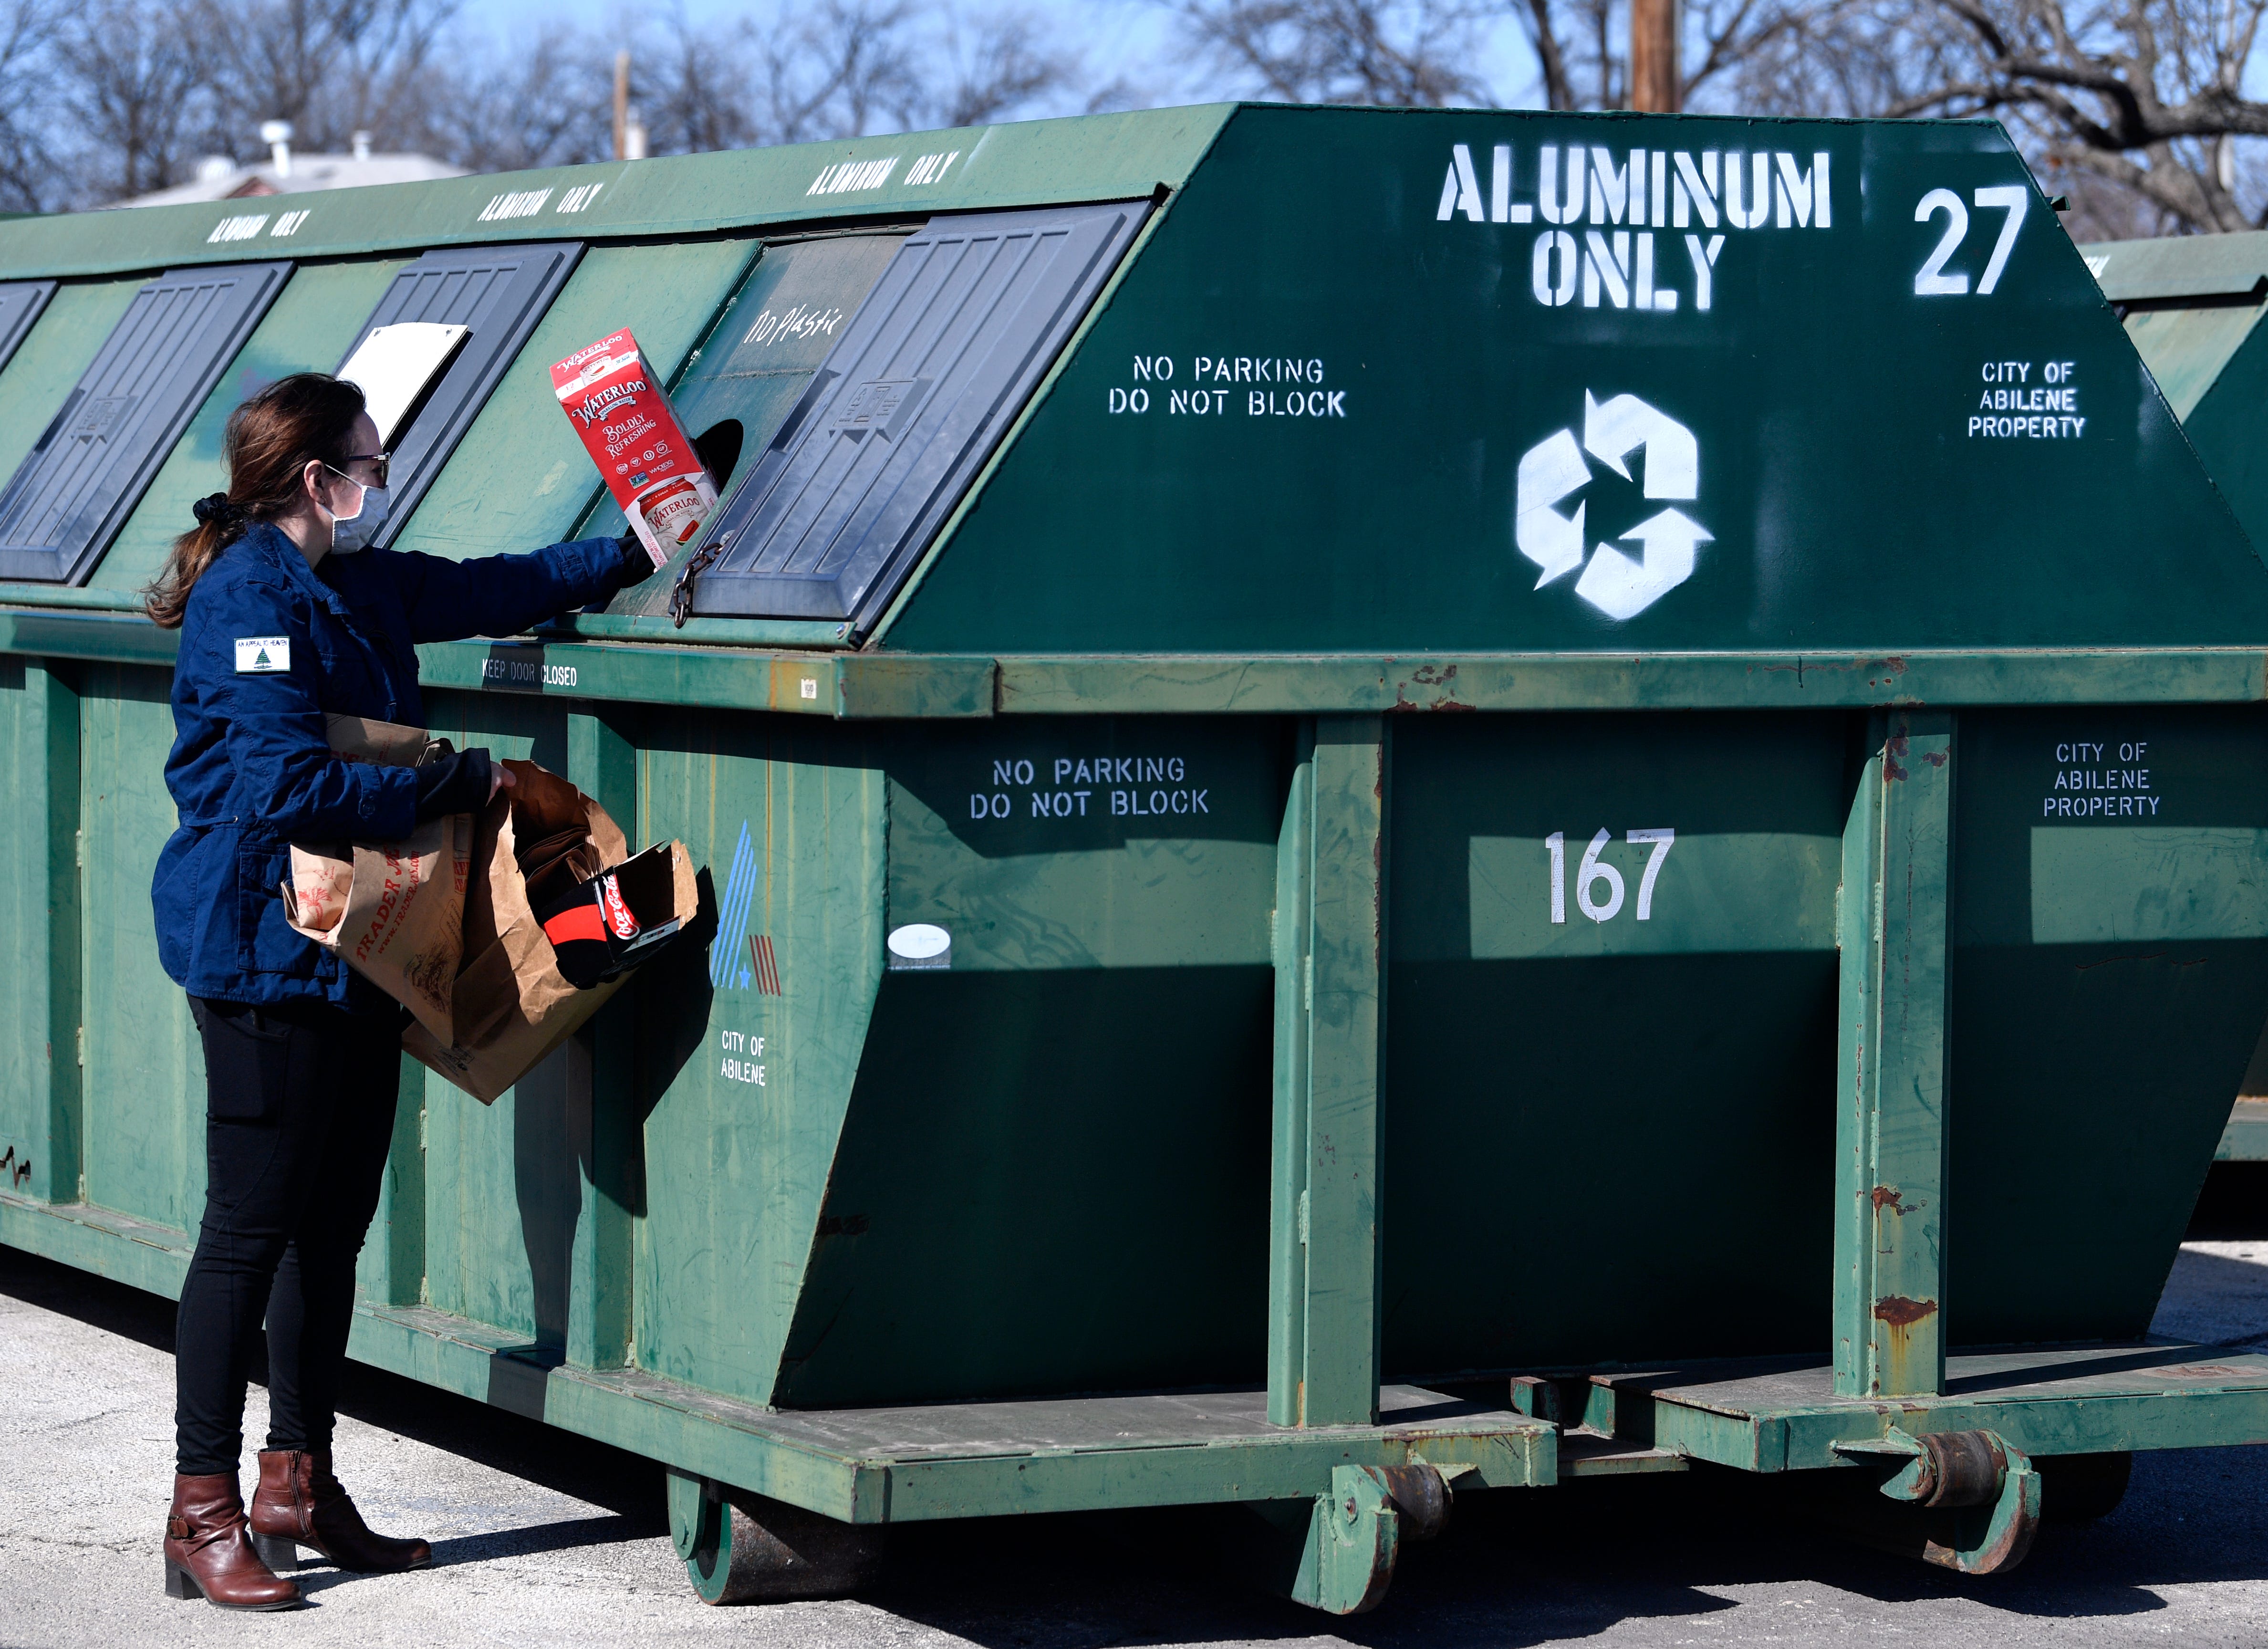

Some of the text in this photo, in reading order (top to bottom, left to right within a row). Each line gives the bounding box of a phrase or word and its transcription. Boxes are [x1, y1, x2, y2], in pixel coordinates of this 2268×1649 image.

[806, 150, 960, 196] ALUMINUM ONLY
[1436, 145, 1831, 228] ALUMINUM
[556, 182, 604, 213] ONLY
[1914, 186, 2028, 295] 27
[1532, 230, 1726, 311] ONLY
[766, 303, 843, 347] Plastic
[1134, 355, 1323, 383] NO PARKING
[1982, 362, 2075, 383] CITY OF
[1109, 387, 1348, 418] DO NOT BLOCK
[1979, 389, 2077, 411] ABILENE
[1968, 416, 2085, 438] PROPERTY
[482, 658, 577, 687] KEEP DOOR CLOSED
[2056, 742, 2147, 762] CITY OF
[993, 757, 1185, 786] NO PARKING
[2054, 769, 2150, 790] ABILENE
[970, 789, 1209, 819] DO NOT BLOCK
[2044, 796, 2160, 817] PROPERTY
[1545, 826, 1675, 924] 167
[356, 878, 401, 963] TRADER
[602, 874, 640, 940] Coca-Cola
[722, 1030, 765, 1057] CITY OF
[721, 1057, 766, 1086] ABILENE
